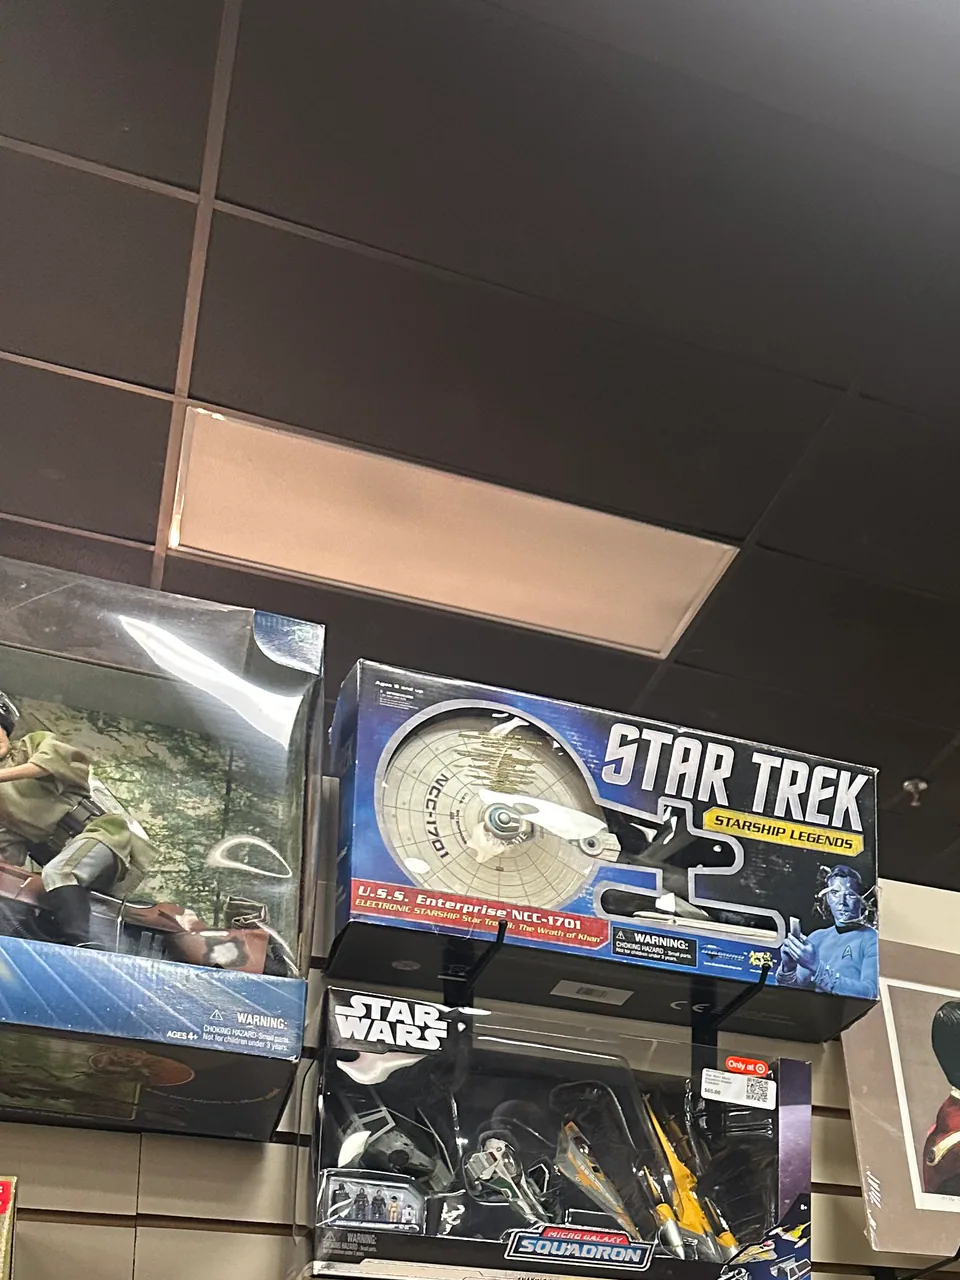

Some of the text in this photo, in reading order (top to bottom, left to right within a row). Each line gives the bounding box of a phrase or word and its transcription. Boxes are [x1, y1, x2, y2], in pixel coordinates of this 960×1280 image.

[602, 723, 870, 832] STAR TREK
[425, 773, 451, 859] NCC-1701
[713, 815, 853, 850] STARSHIP LEGENDS
[358, 886, 581, 930] U.S.S. Enterprise NCC-1701
[355, 898, 602, 943] ELECTRONIC STARSHIP Star Tre The Wrath of Khan
[616, 941, 641, 951] CHOKING
[642, 946, 664, 954] HAZARD
[634, 933, 689, 950] WARNING:
[237, 1012, 288, 1030] WARNING:
[334, 994, 447, 1029] STAR
[166, 1031, 186, 1039] AGES
[203, 1025, 230, 1035] CHOKING
[335, 1015, 449, 1050] WARS
[728, 1060, 755, 1071] Only at
[547, 1229, 625, 1244] MICRO GALAXY
[519, 1239, 642, 1263] SQUADRON
